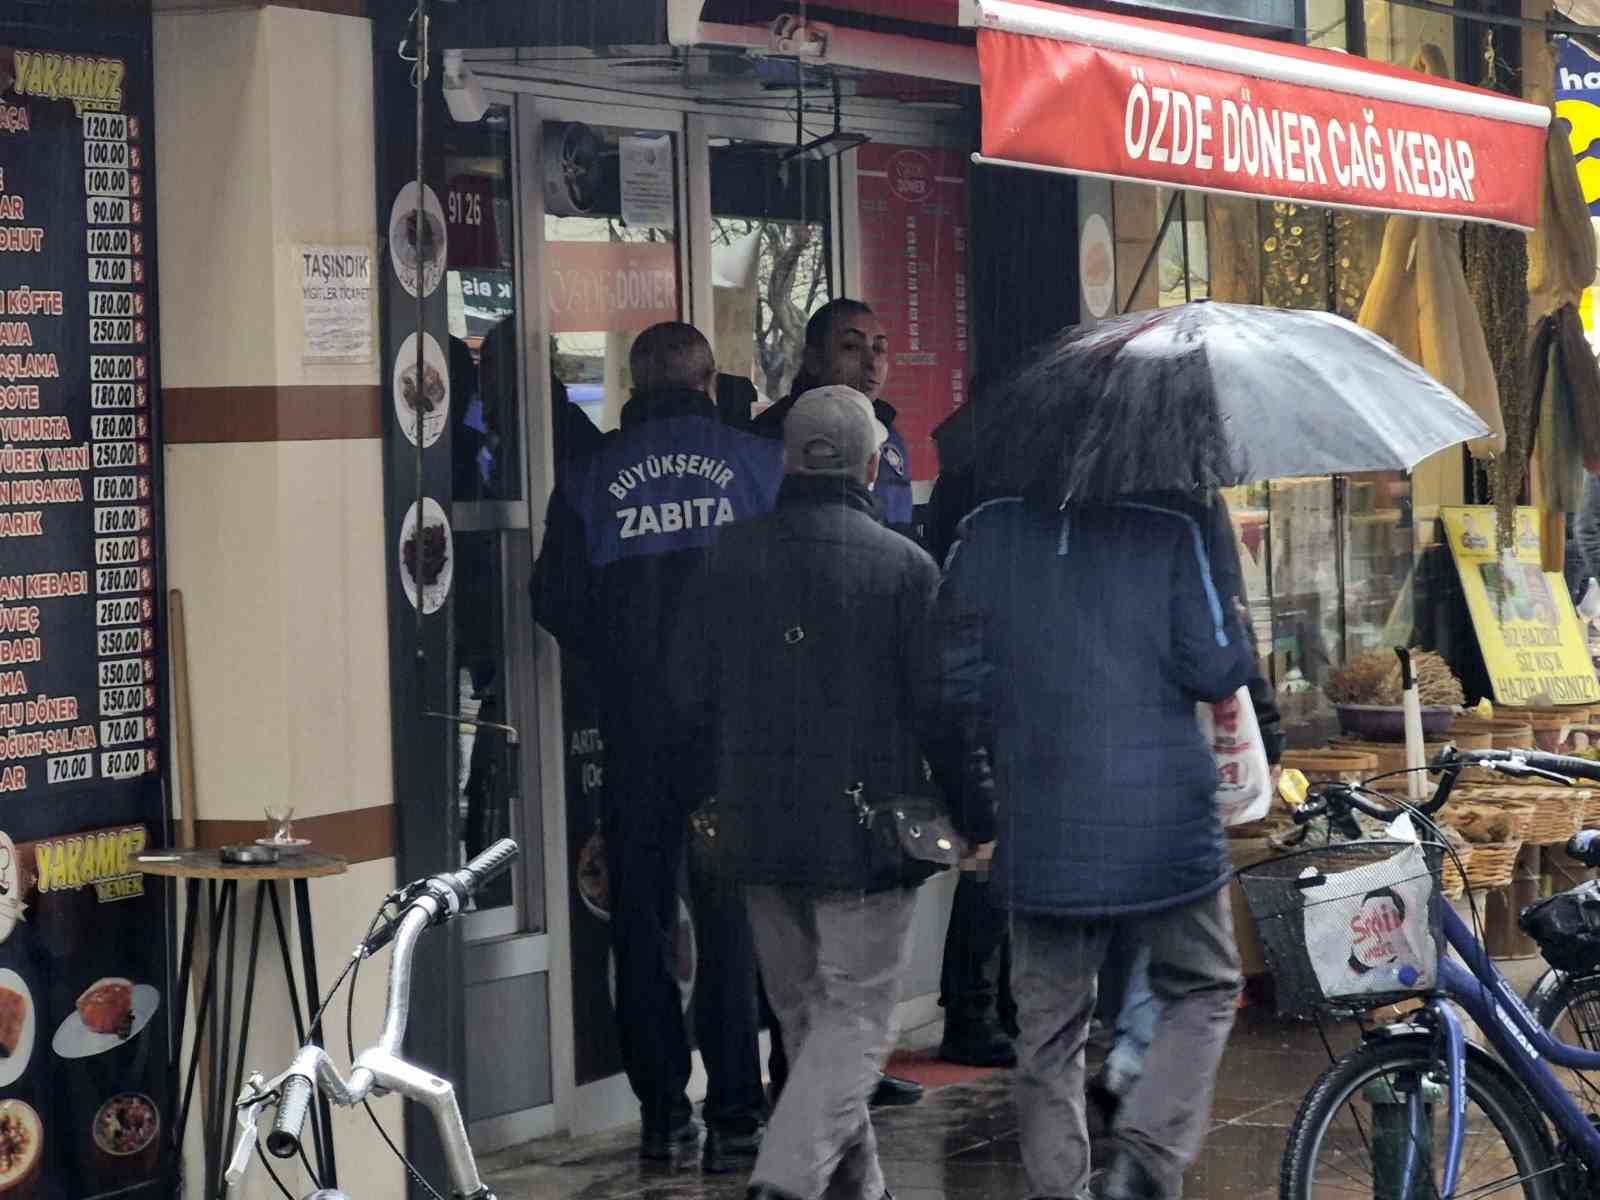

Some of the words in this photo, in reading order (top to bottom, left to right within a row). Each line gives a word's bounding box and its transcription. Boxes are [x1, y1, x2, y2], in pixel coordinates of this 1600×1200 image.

[14, 51, 123, 100] YAKAMOZ
[87, 117, 124, 139] 120.00
[1125, 66, 1214, 170] ÖZDE
[1221, 88, 1328, 185] DÖNER
[1327, 107, 1387, 191] CAĞ
[1387, 127, 1476, 202] KEBAP
[87, 144, 124, 164] 100.00
[88, 171, 125, 191] 100.00
[93, 202, 124, 222] 90.00
[90, 232, 127, 252] 100.00
[95, 261, 126, 280] 70.00
[303, 254, 369, 284] TAŞINDIK
[8, 285, 63, 315] KÖFTE
[94, 294, 130, 314] 180.00
[93, 321, 130, 341] 250.00
[0, 353, 59, 382] AŞLAMA
[94, 358, 132, 378] 200.00
[95, 386, 132, 406] 180.00
[1, 416, 71, 441] YUMURTA
[96, 417, 133, 437] 180.00
[44, 441, 89, 471] YAHNİ
[97, 444, 134, 465] 250.00
[608, 453, 735, 500] BÜYÜKŞEHİR
[11, 478, 83, 505] MUSAKKA
[97, 478, 134, 498] 180.00
[99, 510, 136, 530] 180.00
[616, 497, 735, 539] ZABITA
[99, 541, 136, 562] 150.00
[26, 571, 88, 598] KEBABI
[100, 570, 137, 591] 280.00
[101, 601, 139, 623] 280.00
[101, 631, 139, 653] 350.00
[102, 663, 140, 684] 350.00
[26, 694, 78, 725] DÖNER
[103, 689, 141, 711] 350.00
[107, 720, 138, 742] 70.00
[53, 757, 86, 779] 70.00
